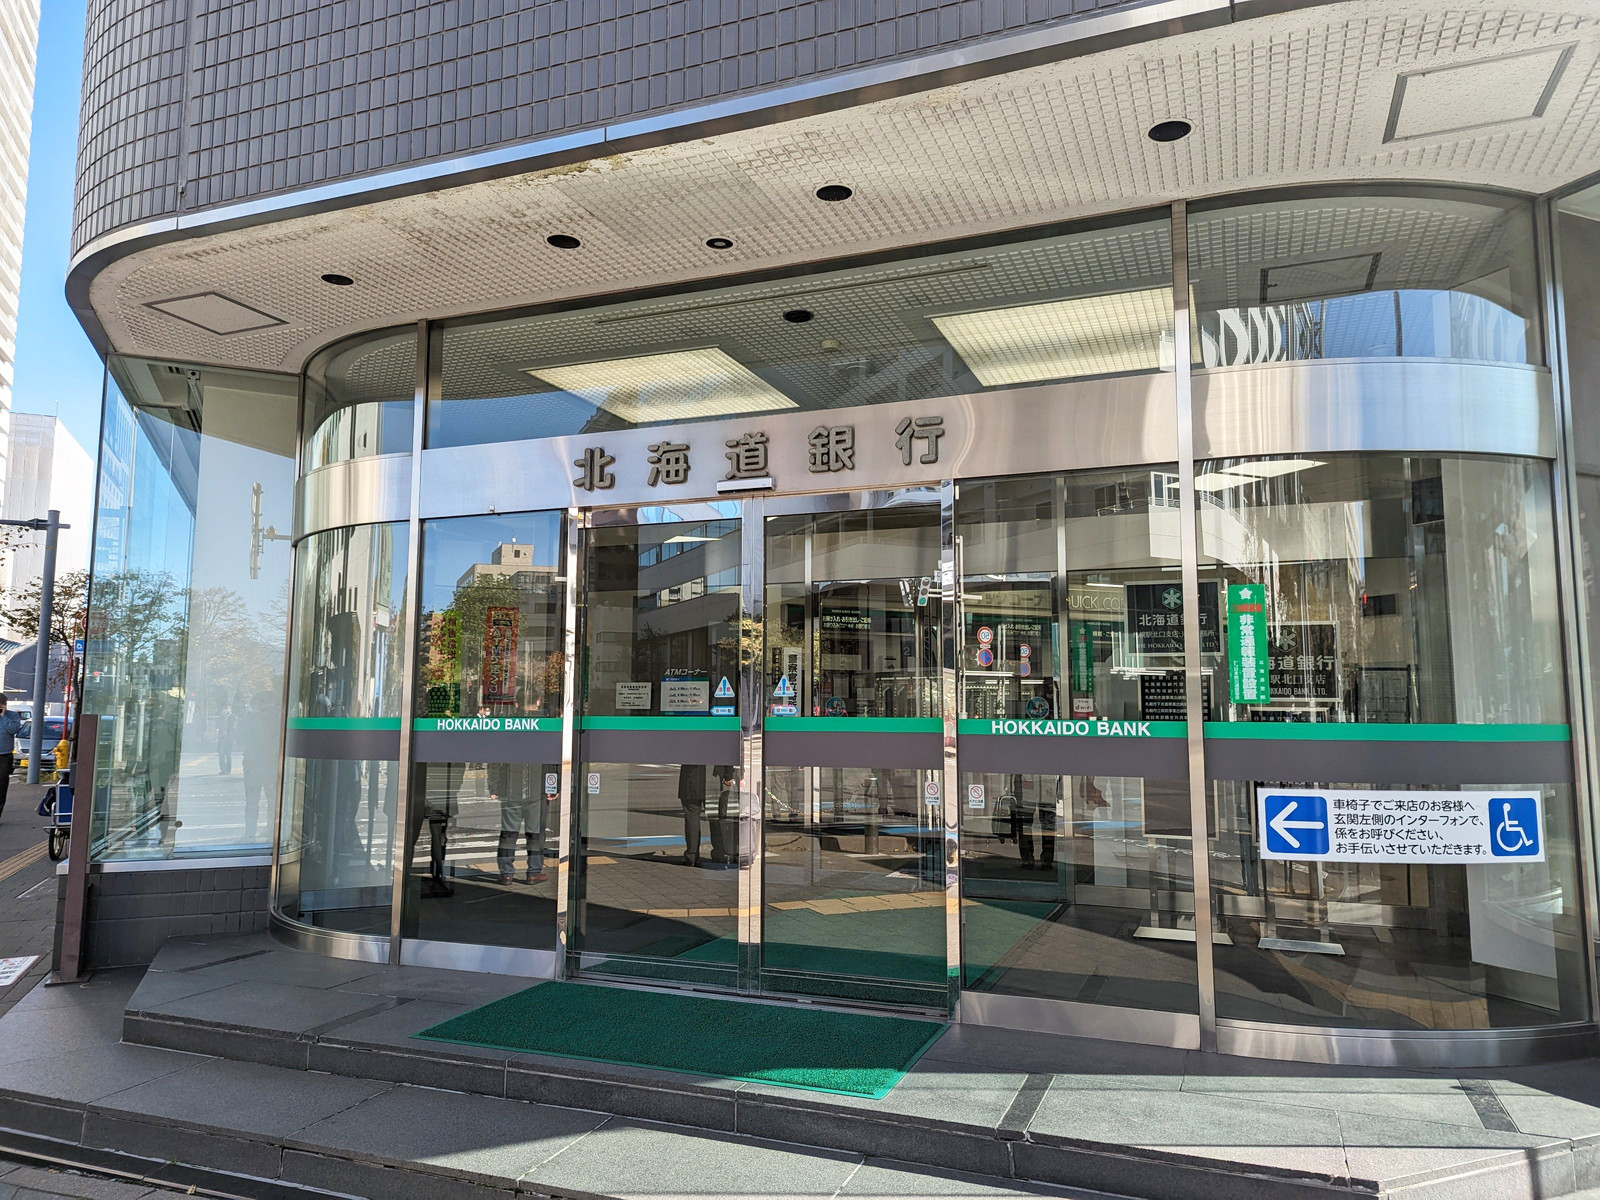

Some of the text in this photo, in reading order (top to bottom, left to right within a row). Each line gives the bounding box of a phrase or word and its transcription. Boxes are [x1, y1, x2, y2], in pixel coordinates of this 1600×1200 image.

[573, 415, 945, 491] 北海道銀行
[1103, 597, 1123, 610] CO
[1268, 655, 1334, 671] 道銀行
[664, 668, 707, 676] ATMコーナー
[437, 718, 539, 731] HOKKAIDO BANK
[991, 720, 1151, 736] HOKKAIDO BANK
[1333, 798, 1475, 812] 車椅子でご来店のお客様へ
[1334, 813, 1484, 826] 玄関左側のインターフォンで、
[1335, 827, 1444, 840] 係をお呼びください、
[1335, 842, 1487, 856] お手伝いさせていただきます。
